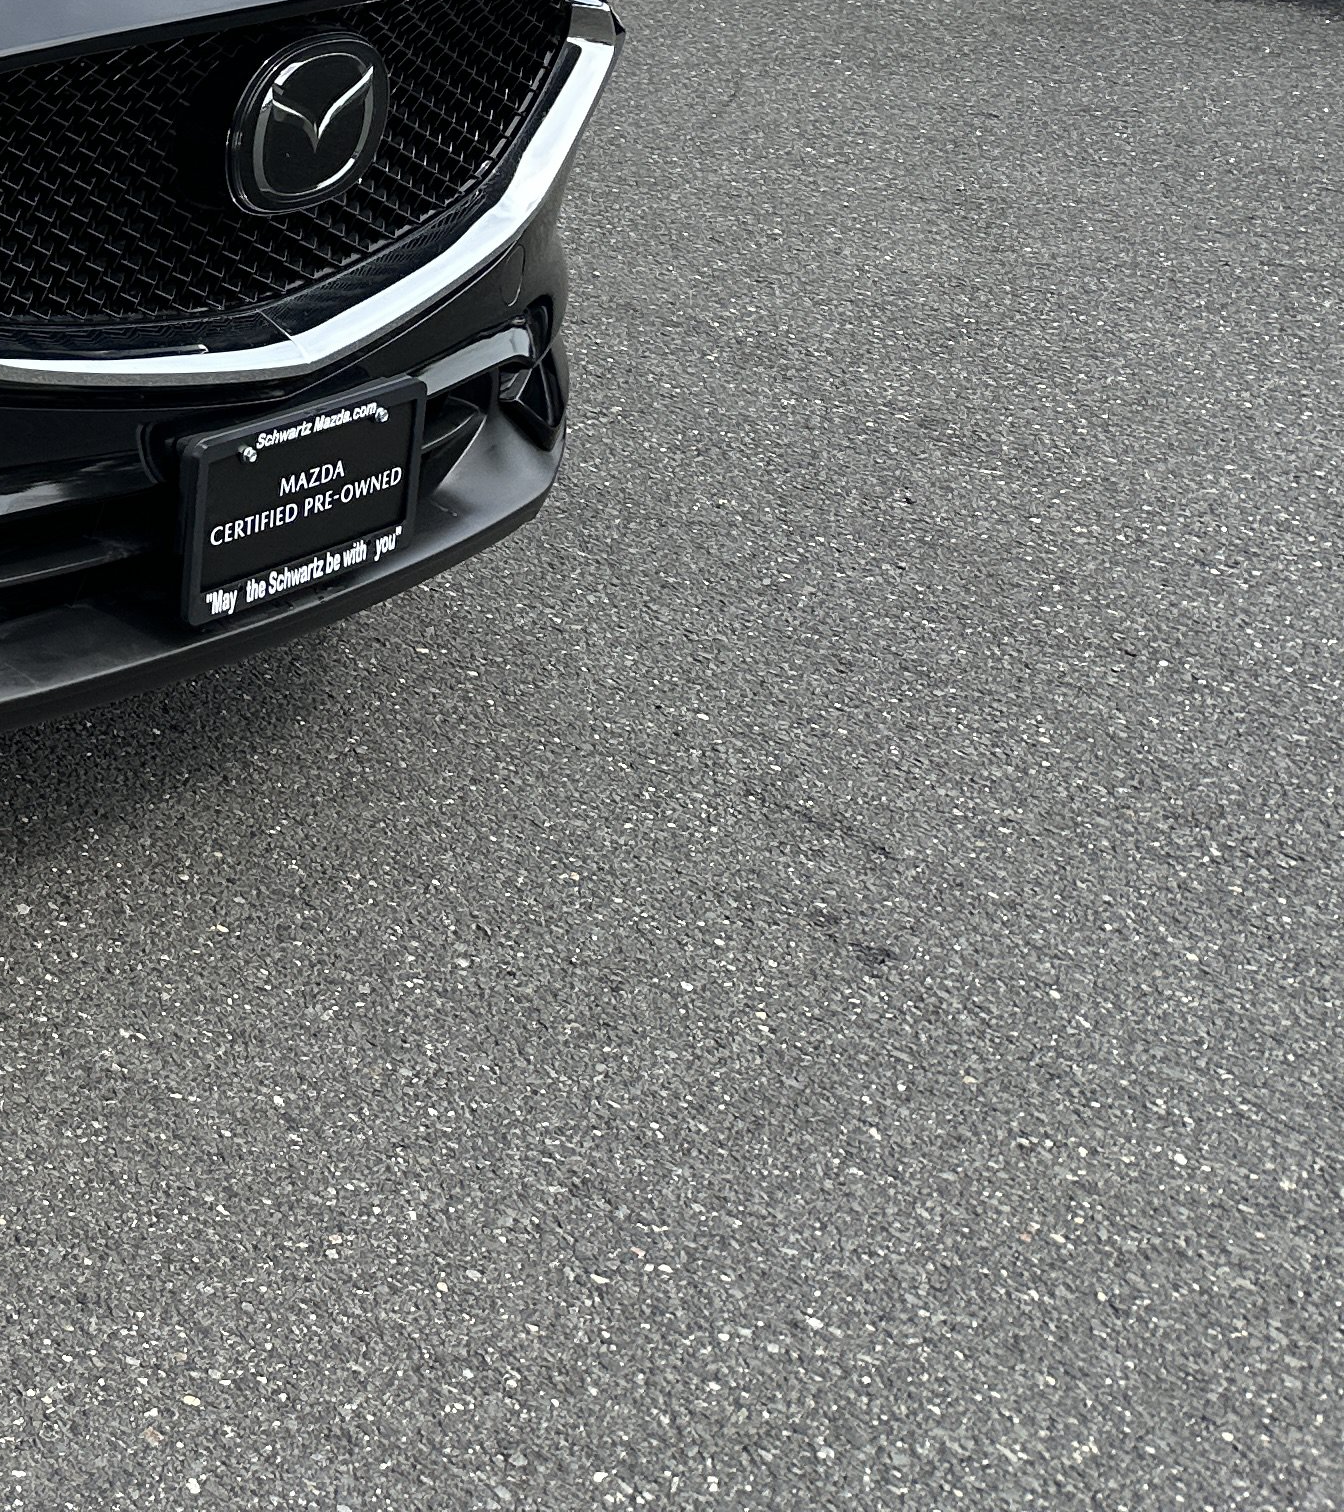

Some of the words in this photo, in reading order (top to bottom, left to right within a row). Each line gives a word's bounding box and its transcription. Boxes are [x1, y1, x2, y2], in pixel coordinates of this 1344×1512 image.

[255, 419, 312, 450] Schwartz
[313, 402, 377, 433] Mazda.com
[210, 502, 298, 547] CERTIFIED
[304, 466, 403, 519] PRE-OWNED
[279, 460, 345, 496] MAZDA
[205, 589, 237, 616] "May
[245, 574, 266, 603] the
[268, 557, 324, 595] Schwartz
[326, 550, 341, 573] be
[343, 543, 367, 568] with
[373, 525, 403, 563] you"
